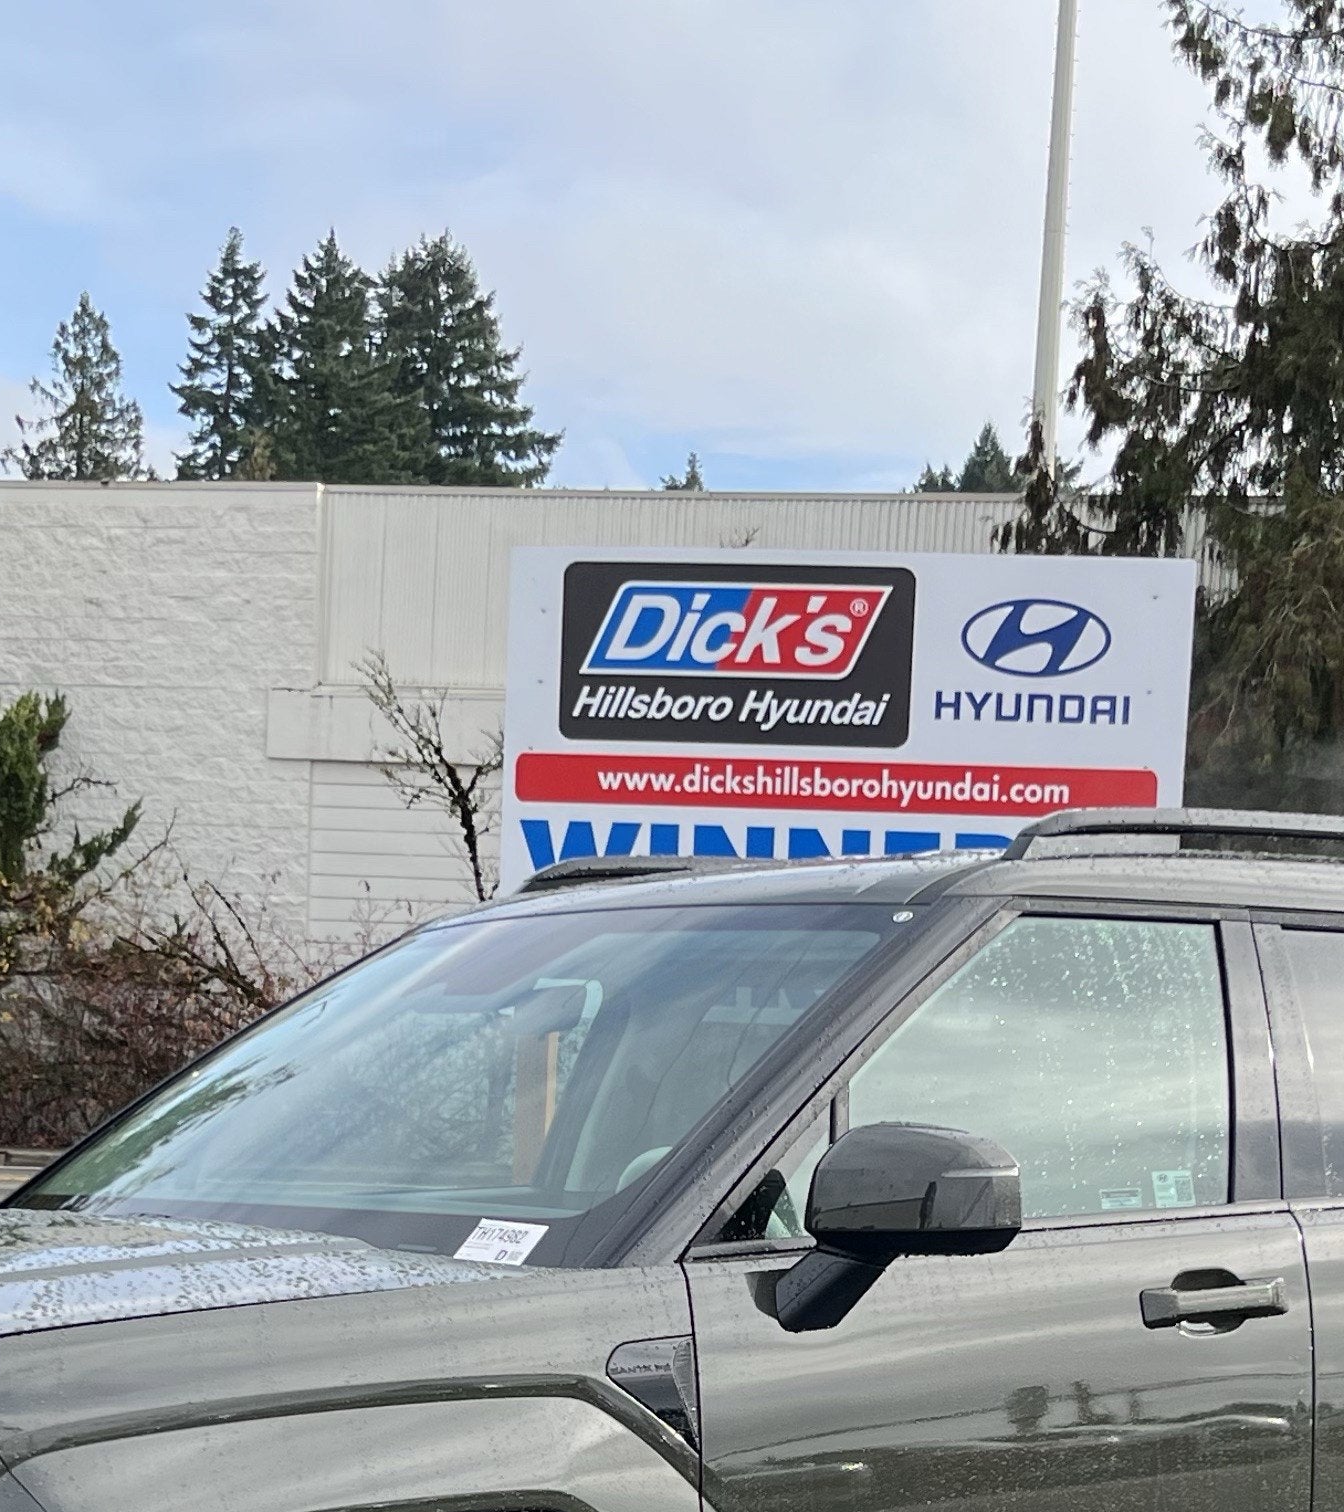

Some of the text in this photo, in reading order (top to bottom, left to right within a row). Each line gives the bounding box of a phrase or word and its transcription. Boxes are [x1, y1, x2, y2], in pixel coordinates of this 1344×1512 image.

[572, 685, 891, 732] Hillsboro Hyundai
[934, 689, 1131, 726] HYUNDAI
[597, 765, 1070, 806] www.dickshillsborohyundai.com
